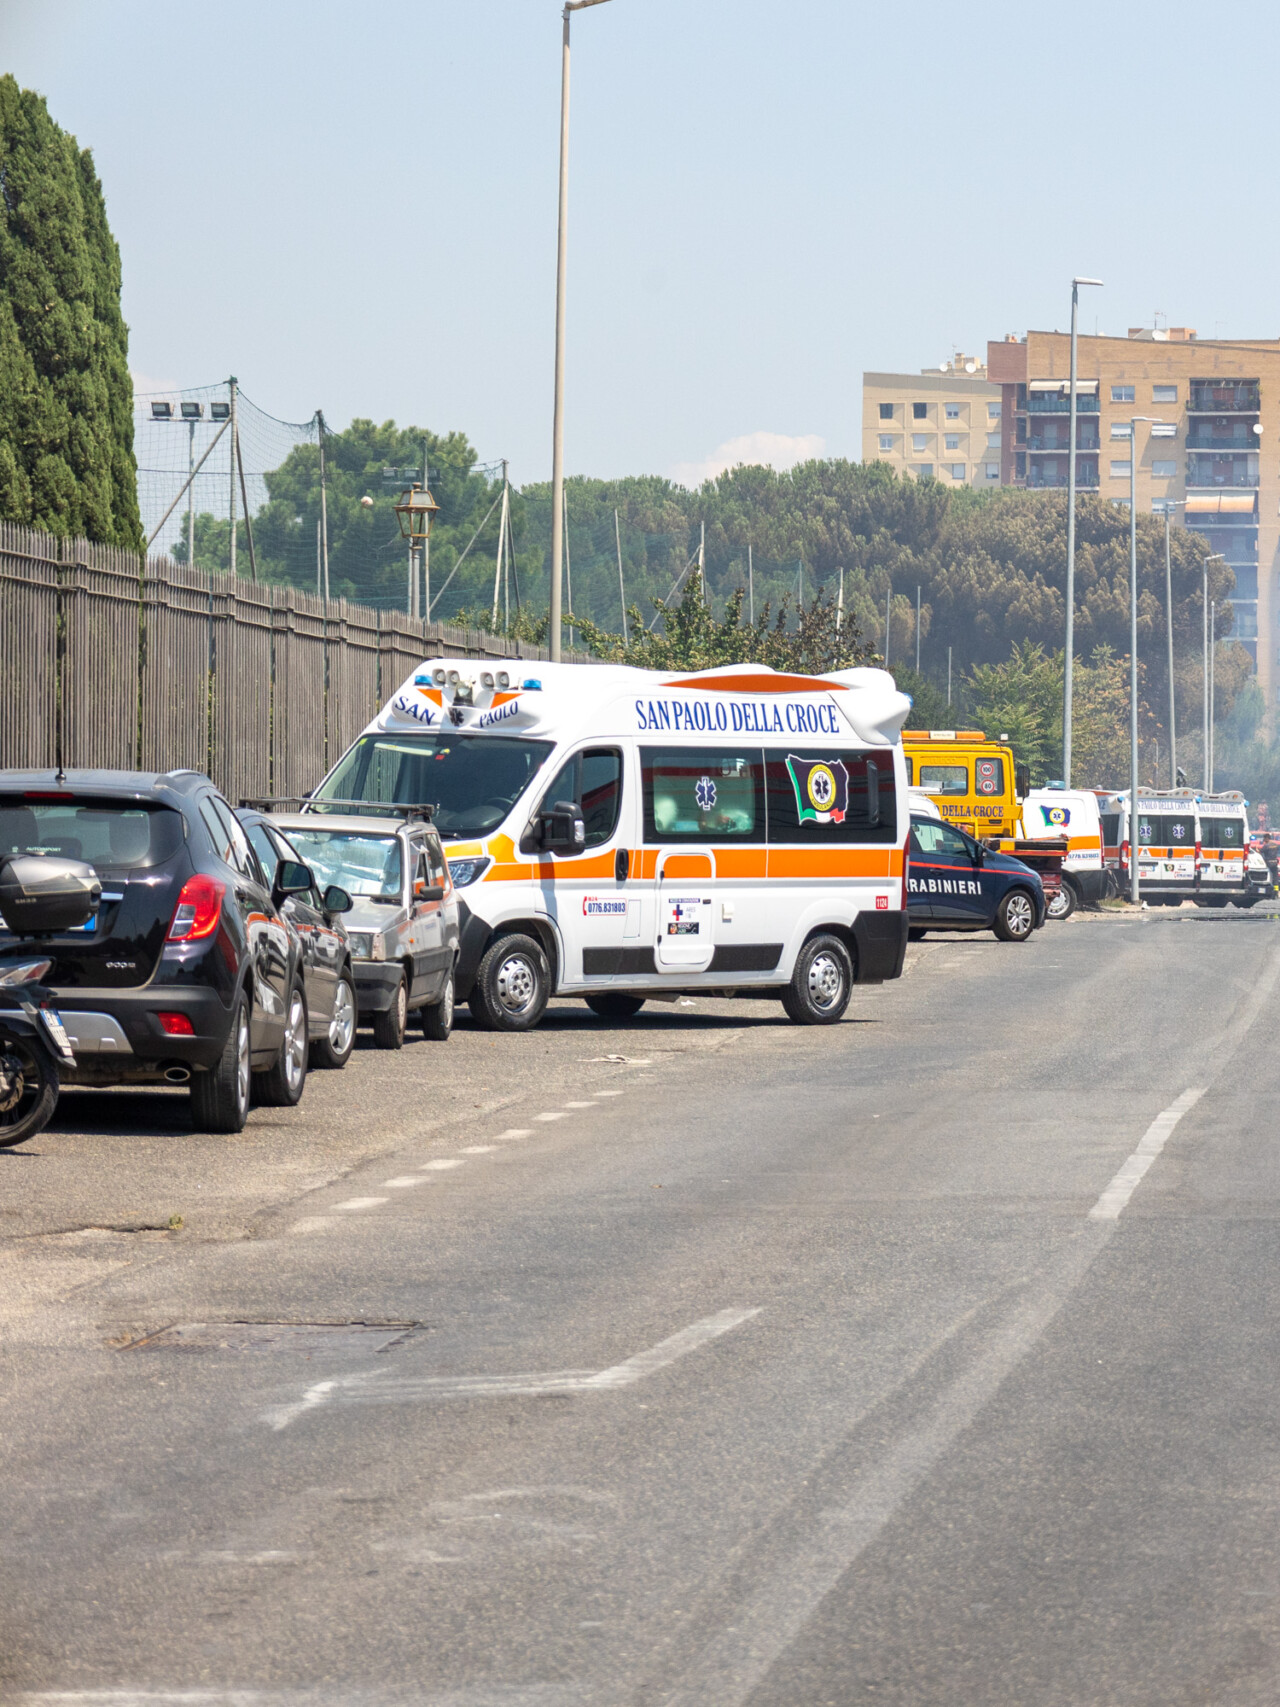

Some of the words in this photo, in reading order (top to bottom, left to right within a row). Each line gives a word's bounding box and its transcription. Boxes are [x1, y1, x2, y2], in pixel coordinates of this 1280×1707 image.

[395, 696, 435, 725] SAN
[479, 700, 519, 728] PAOLO
[635, 699, 671, 731] SAN
[672, 701, 727, 731] PAOLO
[730, 702, 784, 732] DELLA
[786, 704, 840, 733] CROCE
[942, 805, 971, 817] DELLA
[973, 805, 1004, 817] CROCE
[1158, 801, 1174, 810] DELLA
[907, 879, 982, 895] RABINIERI
